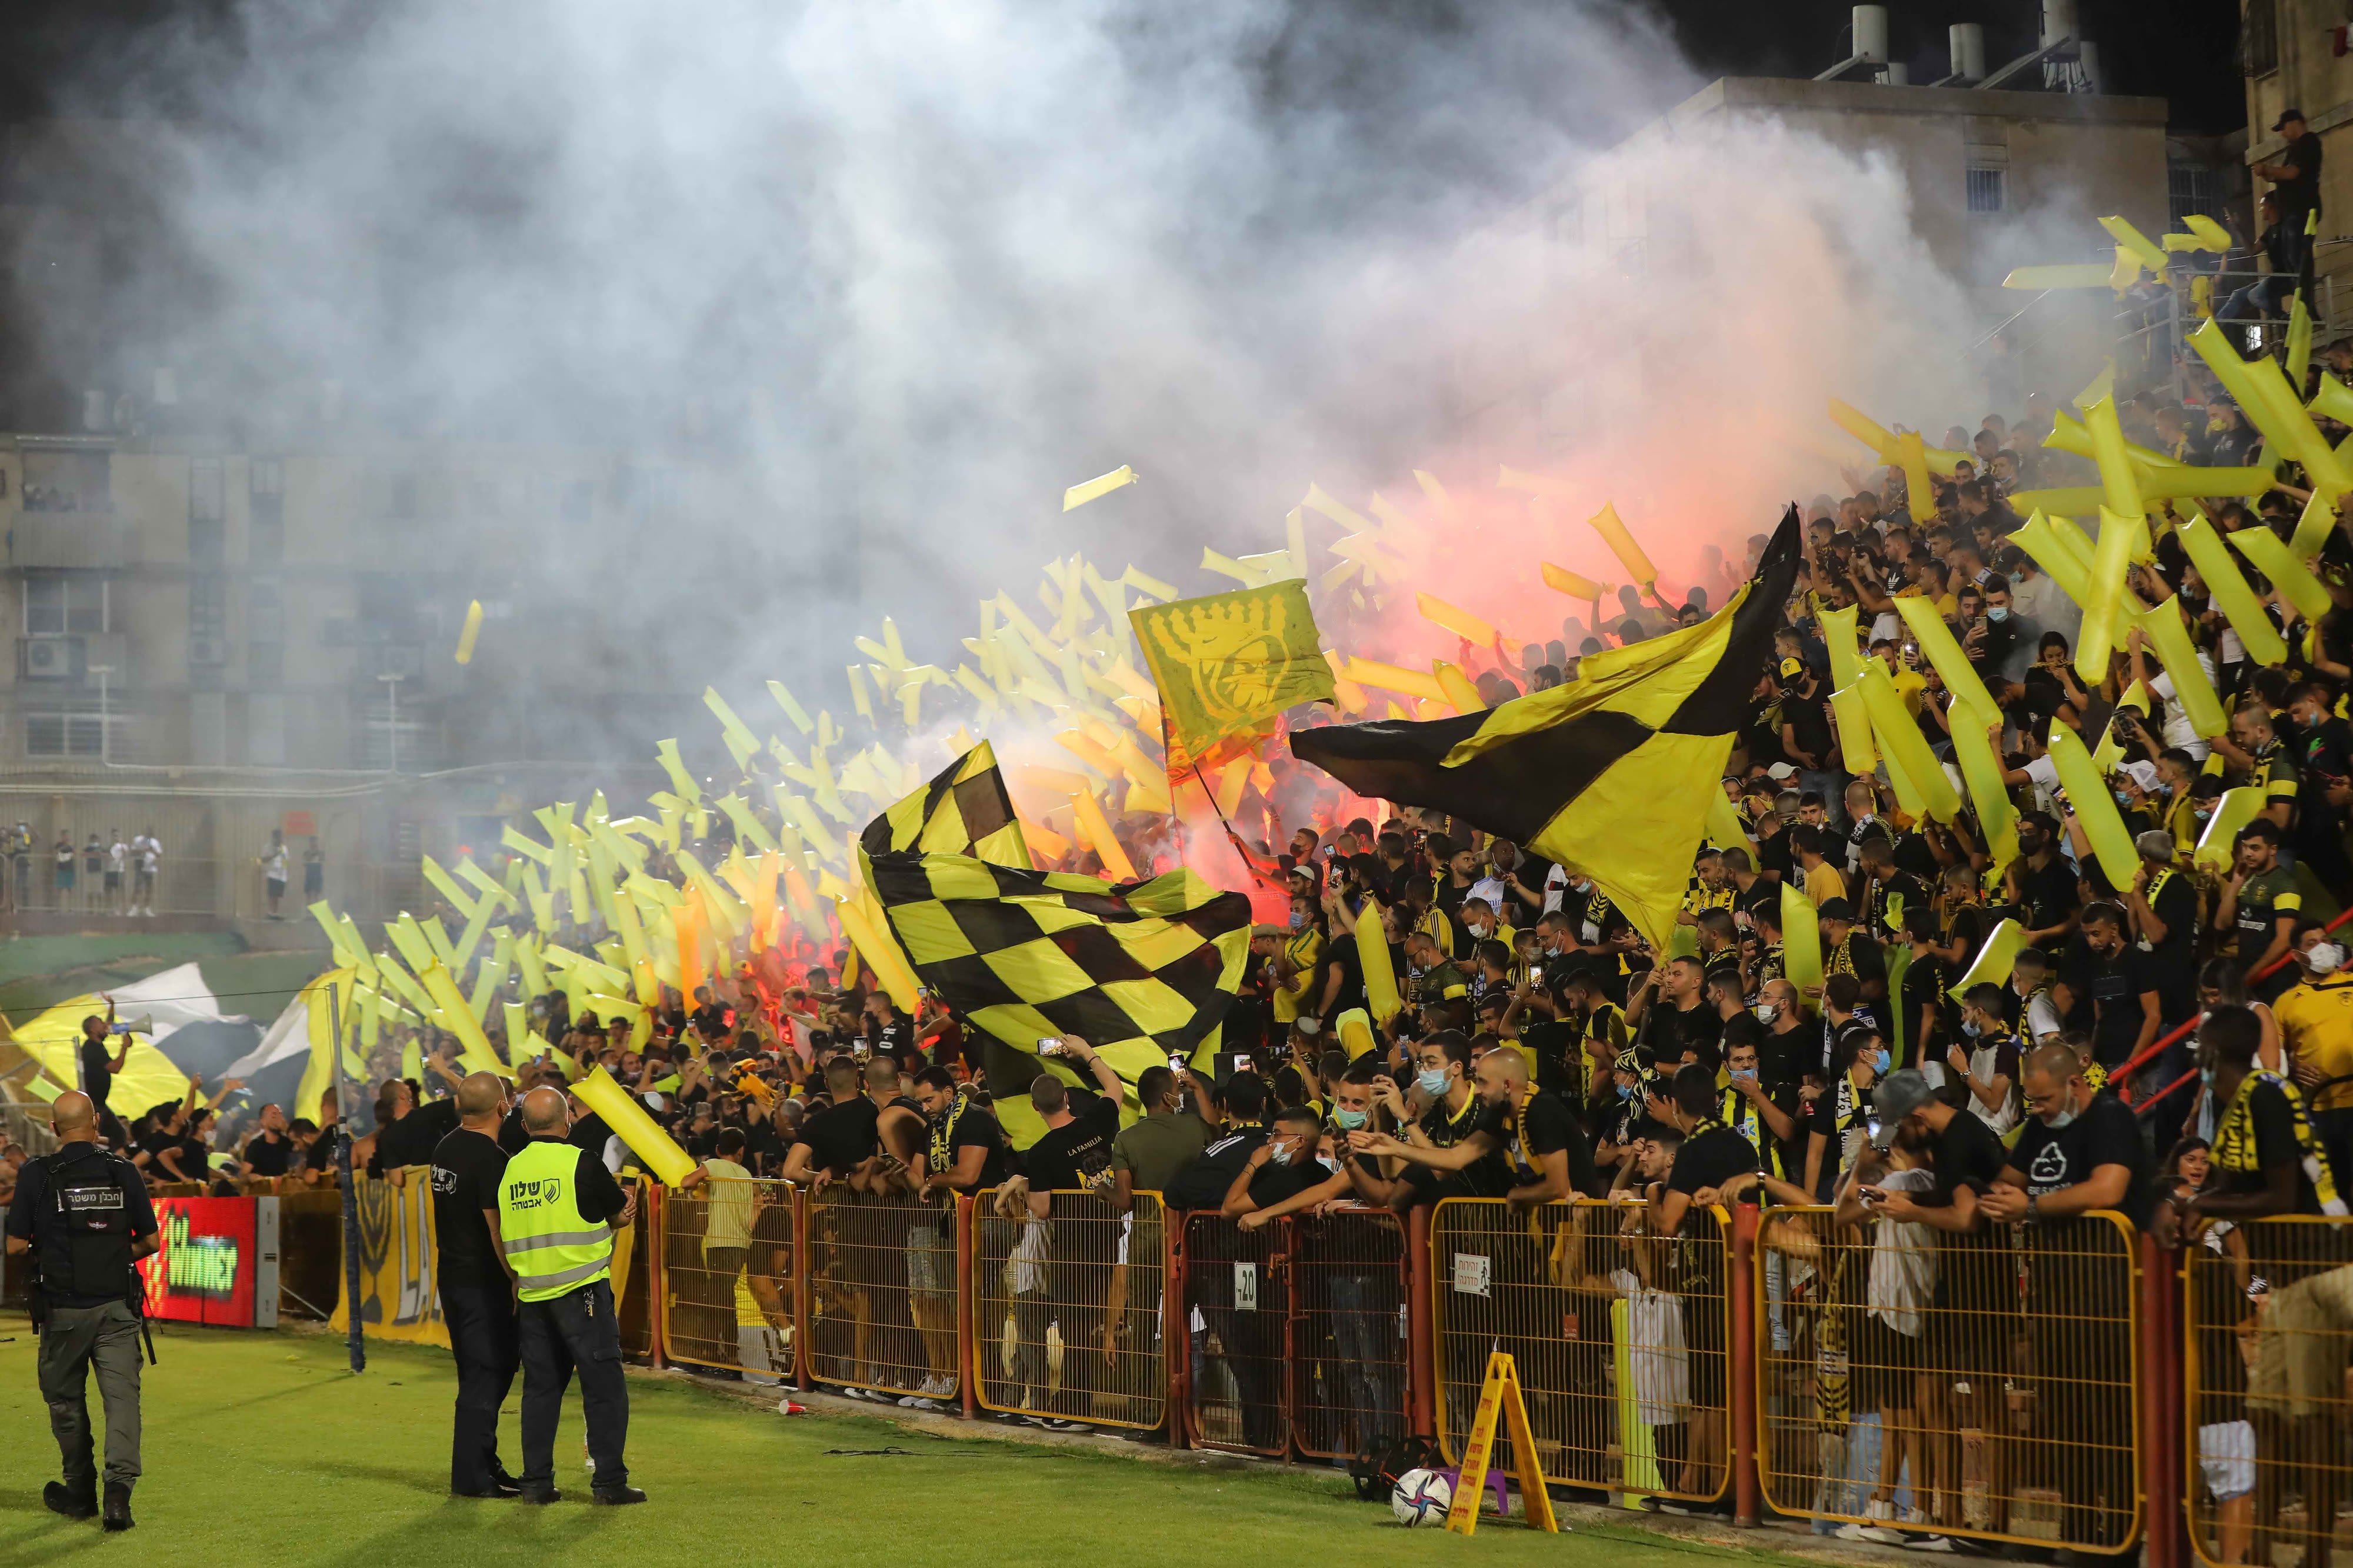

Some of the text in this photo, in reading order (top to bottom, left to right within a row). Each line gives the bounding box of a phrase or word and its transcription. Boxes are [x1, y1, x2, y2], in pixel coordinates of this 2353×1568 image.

[1076, 1136, 1102, 1152] FAMILIA
[509, 1181, 540, 1201] שלון
[68, 1192, 119, 1203] חבלן משטר
[511, 1199, 542, 1211] אבטחה
[1459, 1260, 1478, 1272] זהירות
